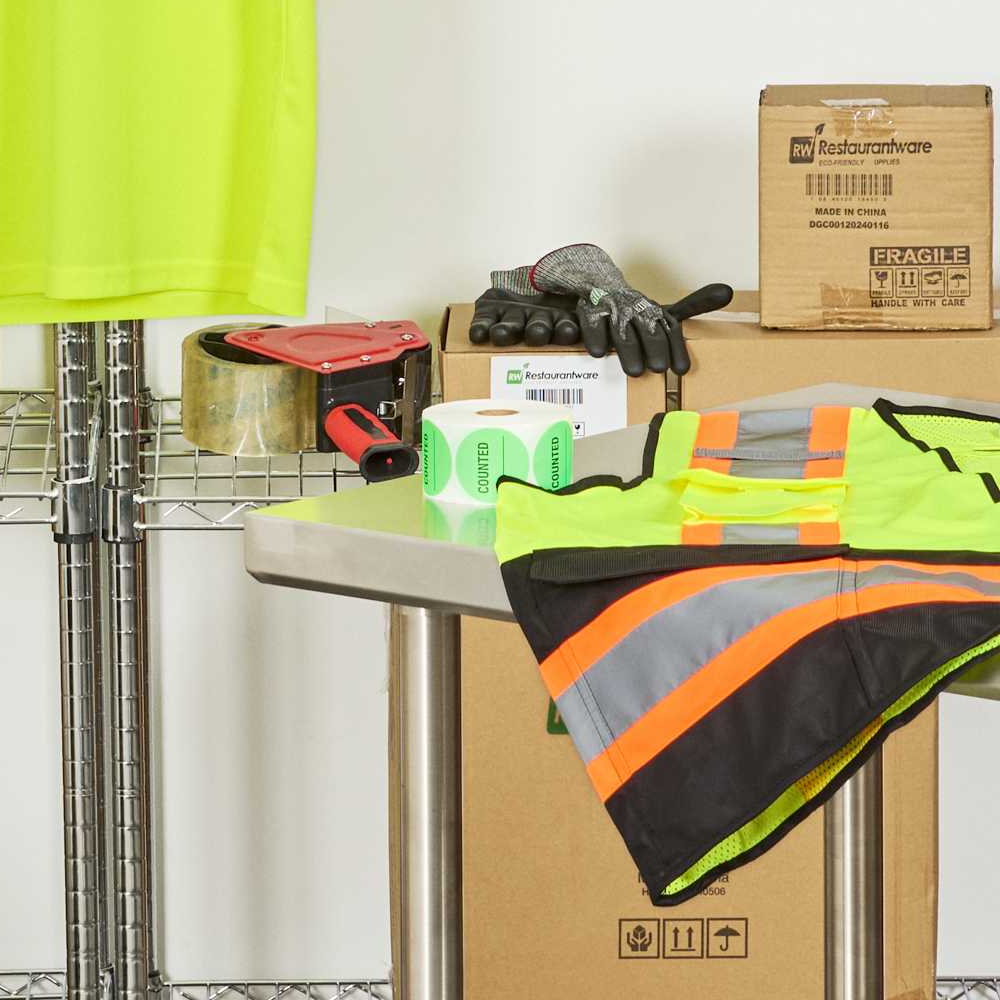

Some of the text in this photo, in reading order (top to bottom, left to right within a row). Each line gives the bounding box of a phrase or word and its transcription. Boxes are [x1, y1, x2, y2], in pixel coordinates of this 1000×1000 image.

[792, 143, 812, 157] RW
[818, 138, 932, 155] Restaurantware
[815, 208, 887, 217] MADE IN CHINA
[809, 220, 889, 230] DGC00120240116
[873, 248, 967, 265] FRAGILE
[871, 298, 966, 308] HANDLE WITH CARE
[525, 371, 599, 380] Restaurantware
[477, 442, 489, 494] COUNTED
[551, 436, 560, 490] COUNTED
